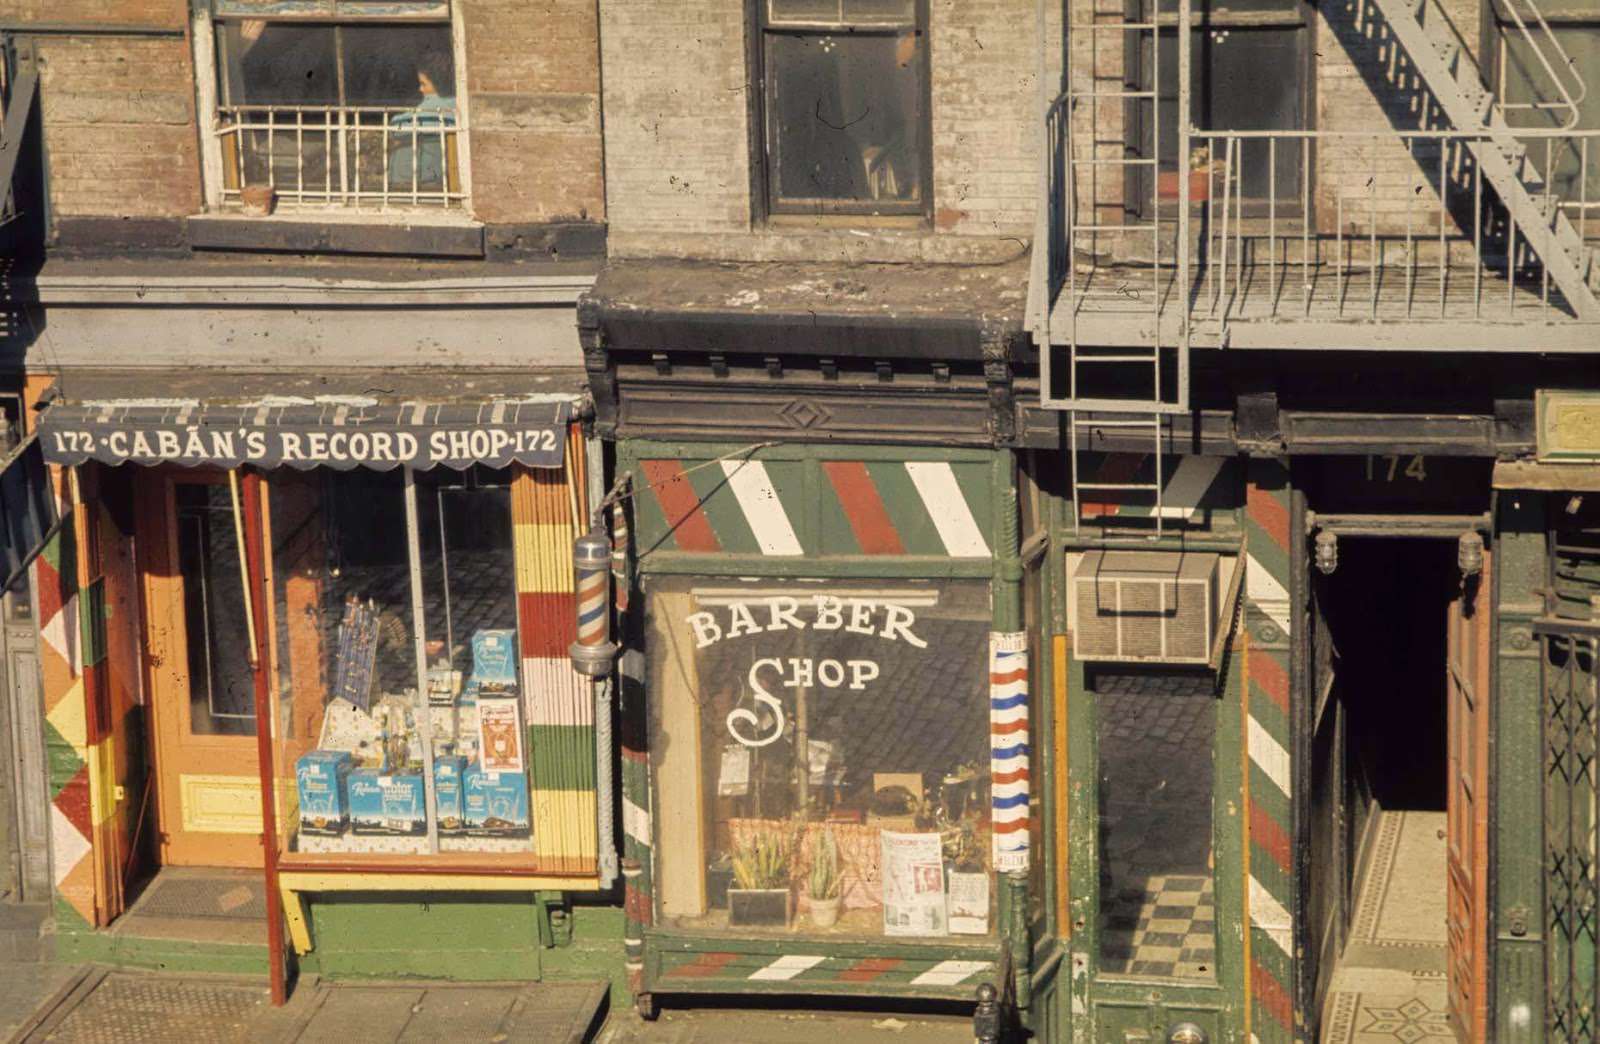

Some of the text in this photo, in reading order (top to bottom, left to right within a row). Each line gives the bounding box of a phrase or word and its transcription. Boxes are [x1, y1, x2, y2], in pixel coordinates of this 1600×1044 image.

[54, 431, 96, 453] 172
[279, 432, 418, 461] RECORD
[429, 429, 508, 460] SHOP
[515, 430, 557, 453] 172
[1367, 452, 1427, 482] 174
[685, 595, 928, 649] BARBER
[726, 658, 880, 747] SHOP
